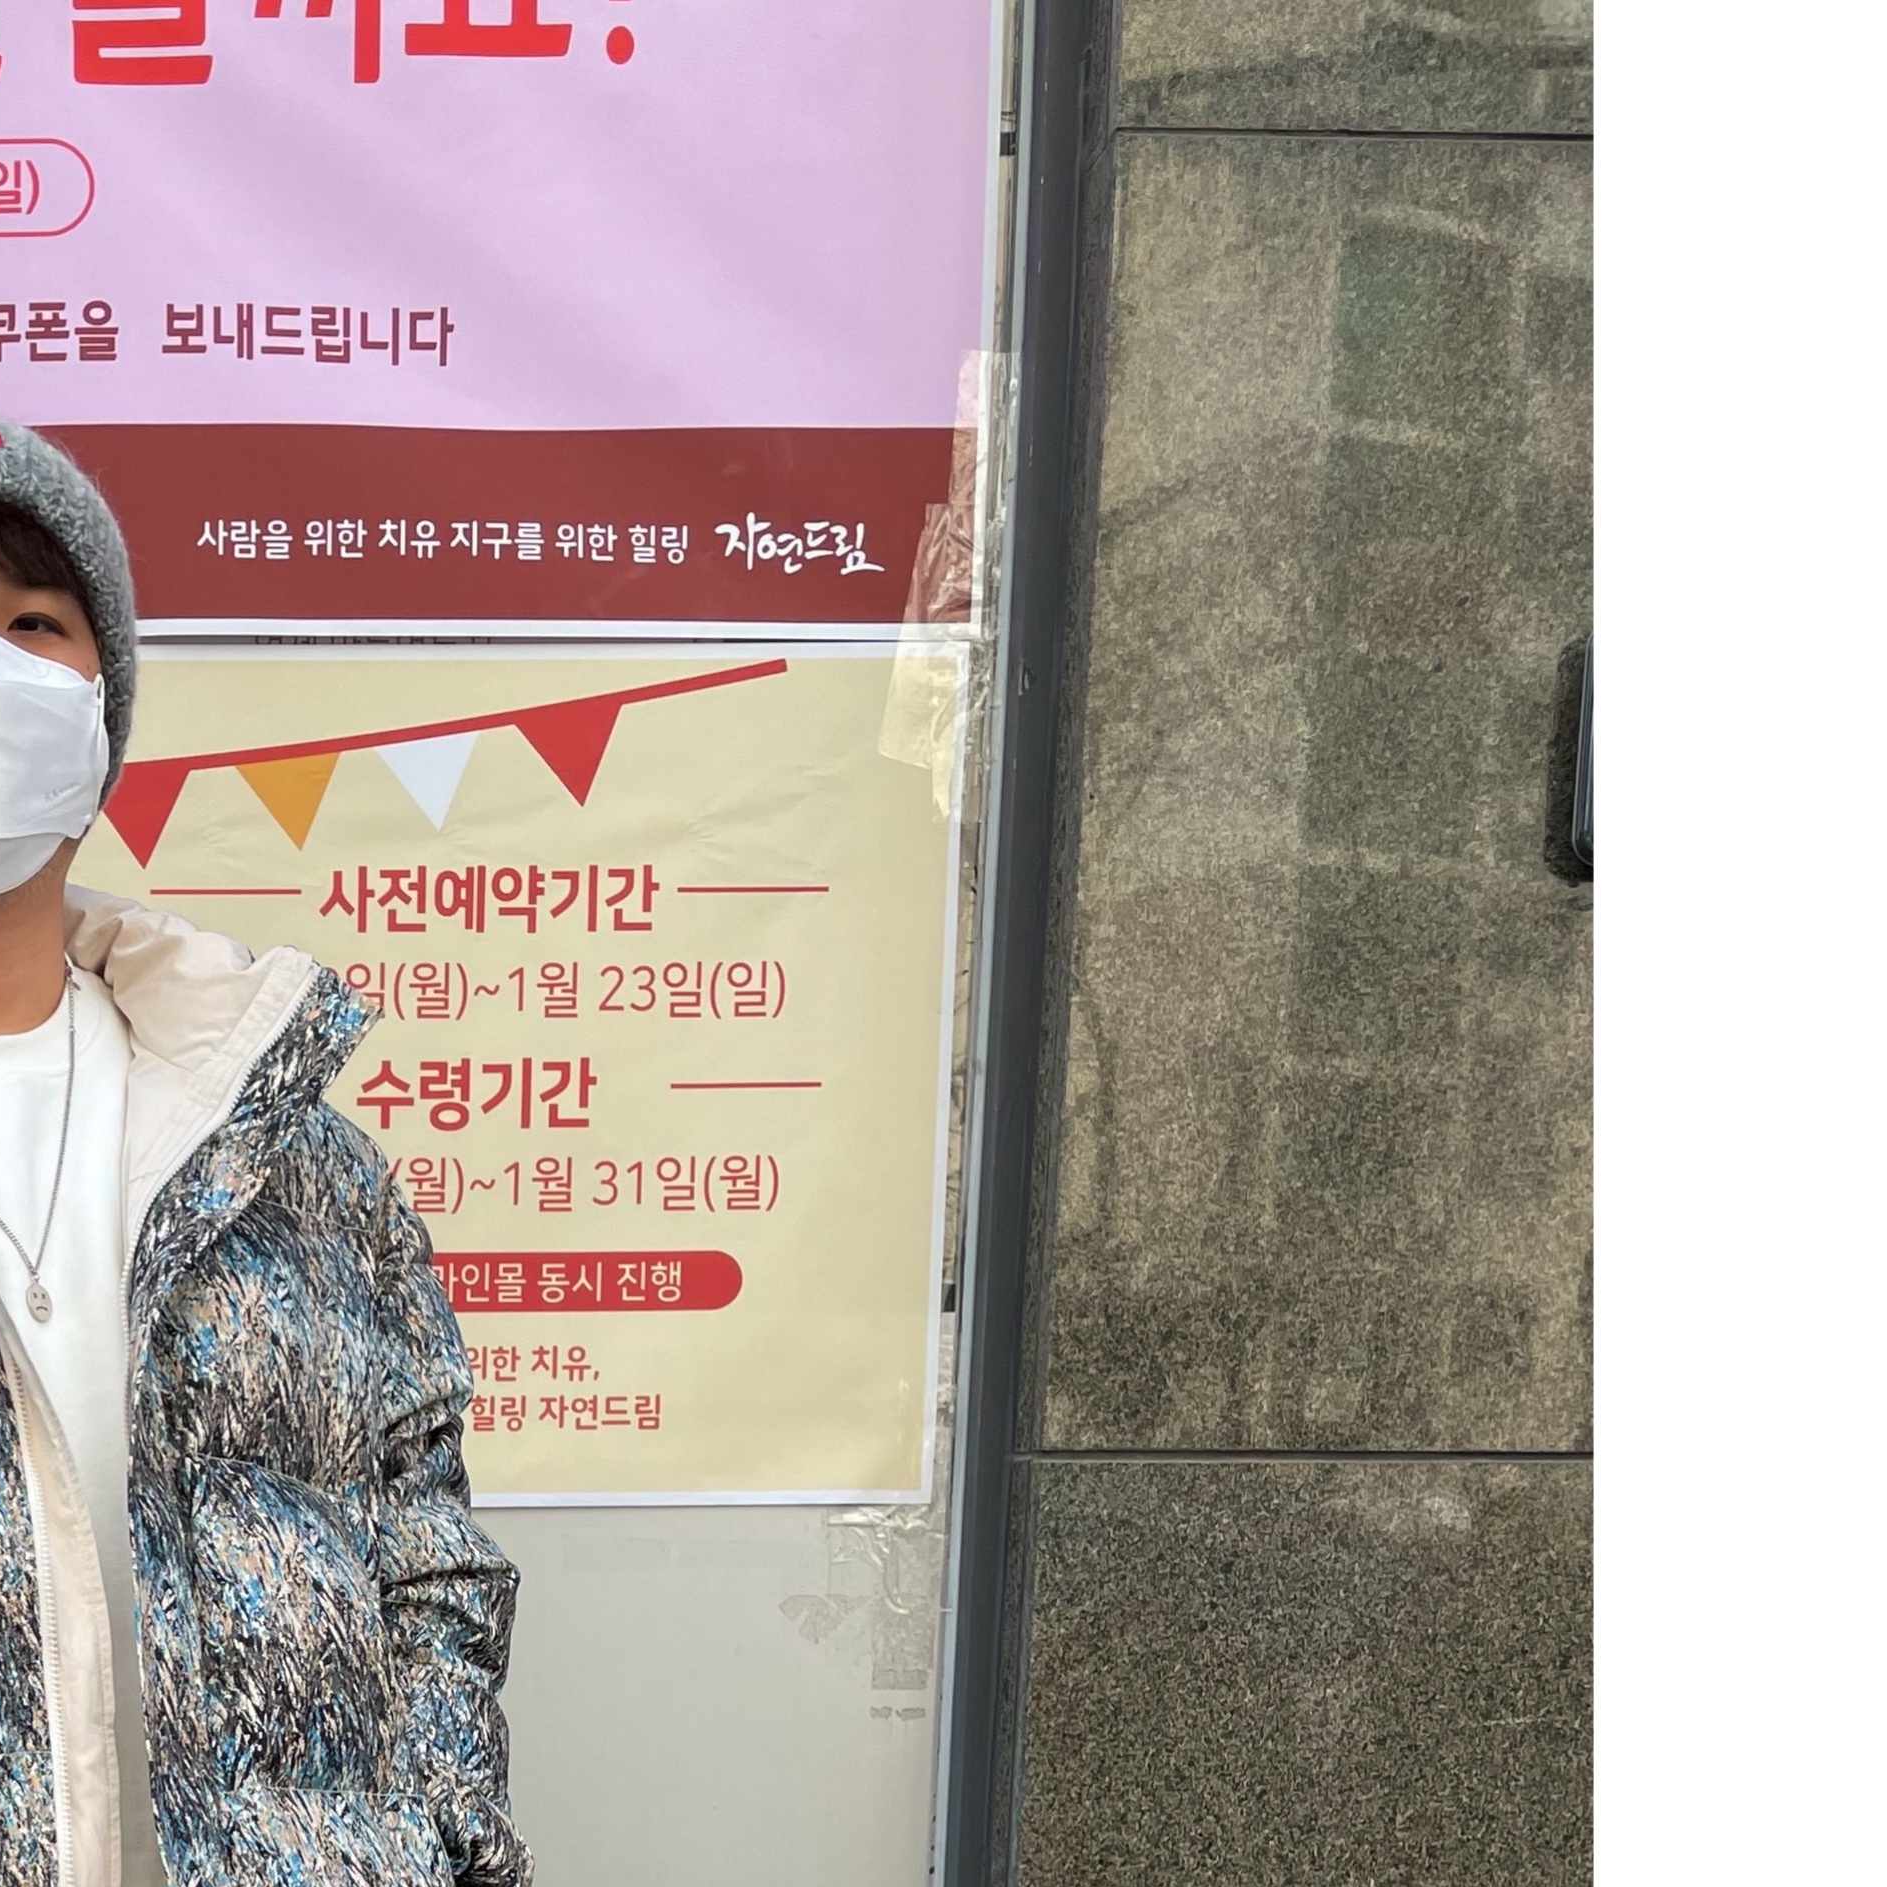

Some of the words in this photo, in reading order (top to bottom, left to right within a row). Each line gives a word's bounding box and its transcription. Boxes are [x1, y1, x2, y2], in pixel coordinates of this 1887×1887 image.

[162, 304, 454, 366] 보내드립니다
[198, 520, 292, 559] 사람을
[304, 519, 367, 557] 위한
[379, 520, 440, 558] 치유
[451, 521, 544, 560] 지구를
[556, 524, 617, 561] 위한
[629, 525, 687, 563] 힐링
[715, 513, 884, 574] 자연드림
[320, 865, 659, 933] 사전예약기간
[324, 961, 579, 1021] 일(월)~1월
[599, 961, 785, 1018] 23일(일)
[356, 1057, 597, 1131] 수령기간
[593, 1155, 778, 1212] 31일(월)
[538, 1262, 601, 1302] 동시
[618, 1262, 681, 1301] 진행
[466, 1345, 521, 1382] 위한
[532, 1346, 599, 1381] 치유,
[470, 1394, 527, 1432] 힐링
[539, 1394, 660, 1430] 자연드림
